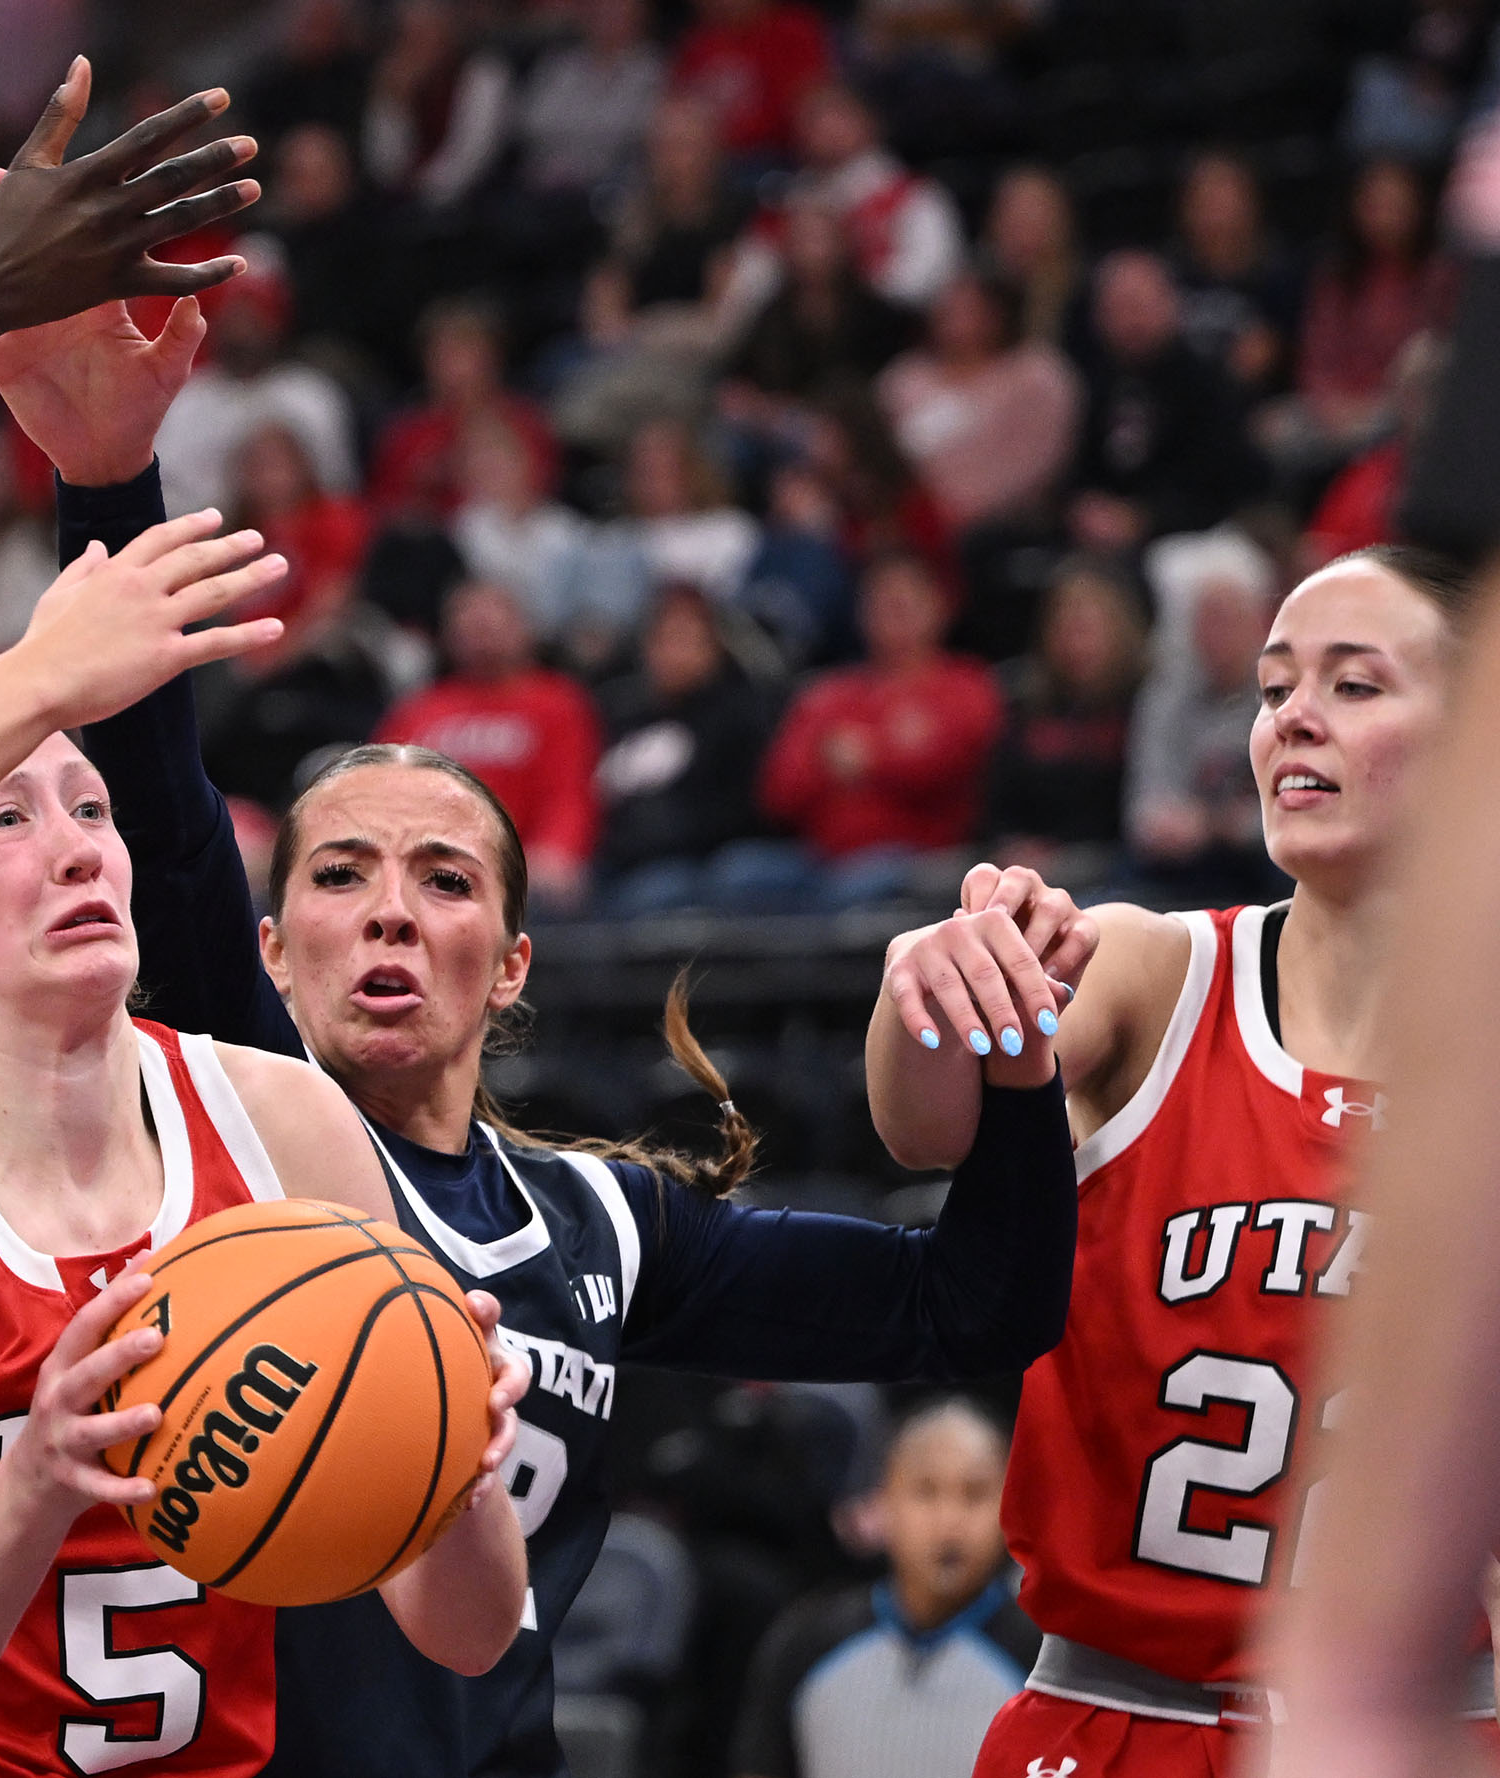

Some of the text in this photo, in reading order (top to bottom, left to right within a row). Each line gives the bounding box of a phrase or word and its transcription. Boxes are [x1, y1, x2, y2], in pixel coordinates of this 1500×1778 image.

[148, 1342, 319, 1554] Wilson
[1131, 1348, 1346, 1587] 2
[57, 1559, 207, 1778] 5
